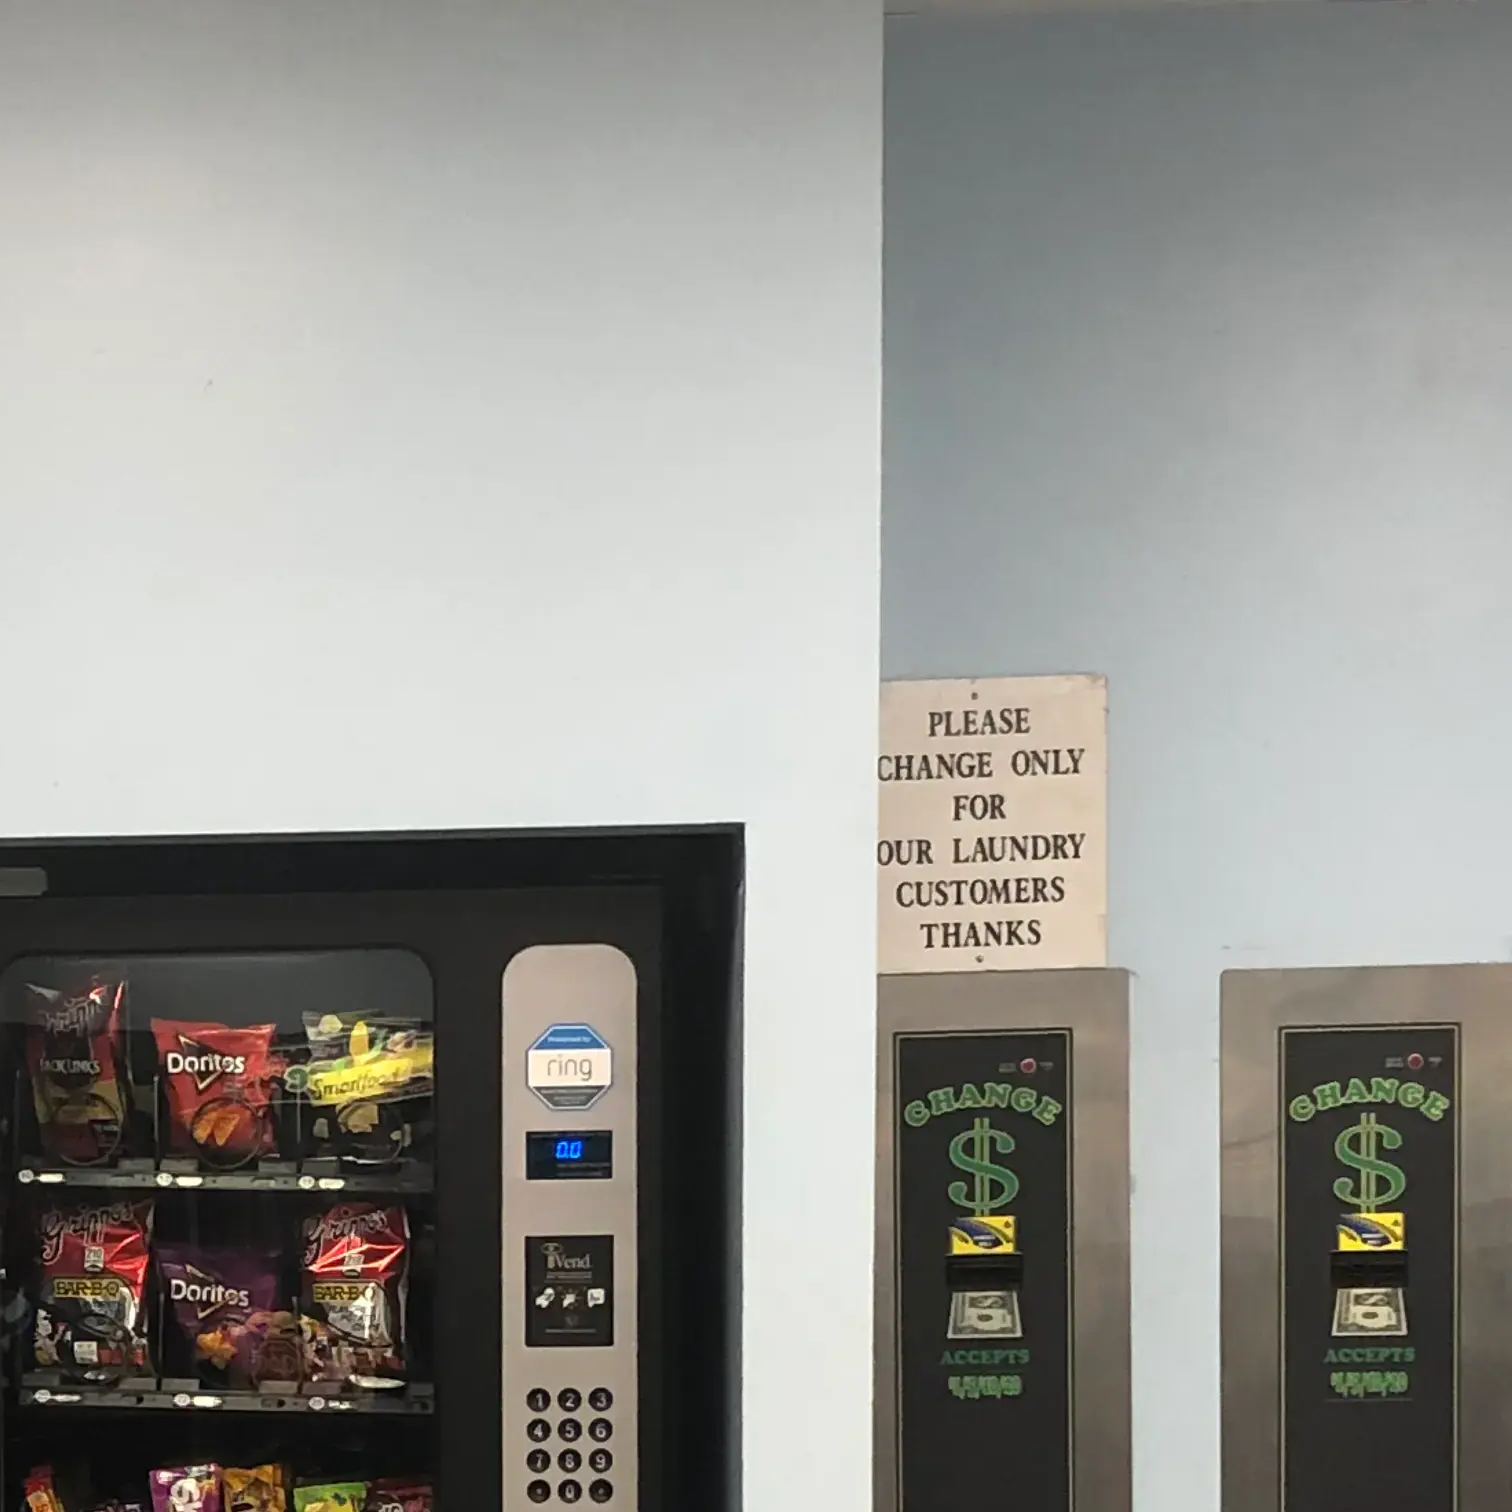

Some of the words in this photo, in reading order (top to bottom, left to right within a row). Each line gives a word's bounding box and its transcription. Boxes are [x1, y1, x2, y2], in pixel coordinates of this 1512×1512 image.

[928, 708, 1031, 737] PLEASE
[877, 752, 993, 781] CHANGE
[1011, 748, 1085, 777] ONLY
[952, 794, 1006, 821] FOR
[877, 839, 934, 866] OUR
[952, 833, 1086, 864] LAUNDRY
[895, 876, 1065, 908] CUSTOMERS
[920, 919, 1042, 948] THANKS
[167, 1052, 246, 1074] Doritos
[547, 1054, 593, 1082] ring
[904, 1082, 1063, 1127] CHANGE
[1289, 1077, 1451, 1122] CHANGE
[171, 1279, 249, 1306] Doritos
[941, 1349, 1030, 1365] ACCEPTS
[1323, 1347, 1416, 1363] ACCEPTS
[536, 1393, 544, 1409] 1
[566, 1393, 575, 1407] 2
[596, 1392, 607, 1407] 3
[534, 1423, 543, 1438] 4
[565, 1423, 575, 1438] 5
[596, 1423, 606, 1438] 6
[536, 1454, 544, 1469] 7
[565, 1453, 575, 1468] 8
[596, 1453, 606, 1468] 9
